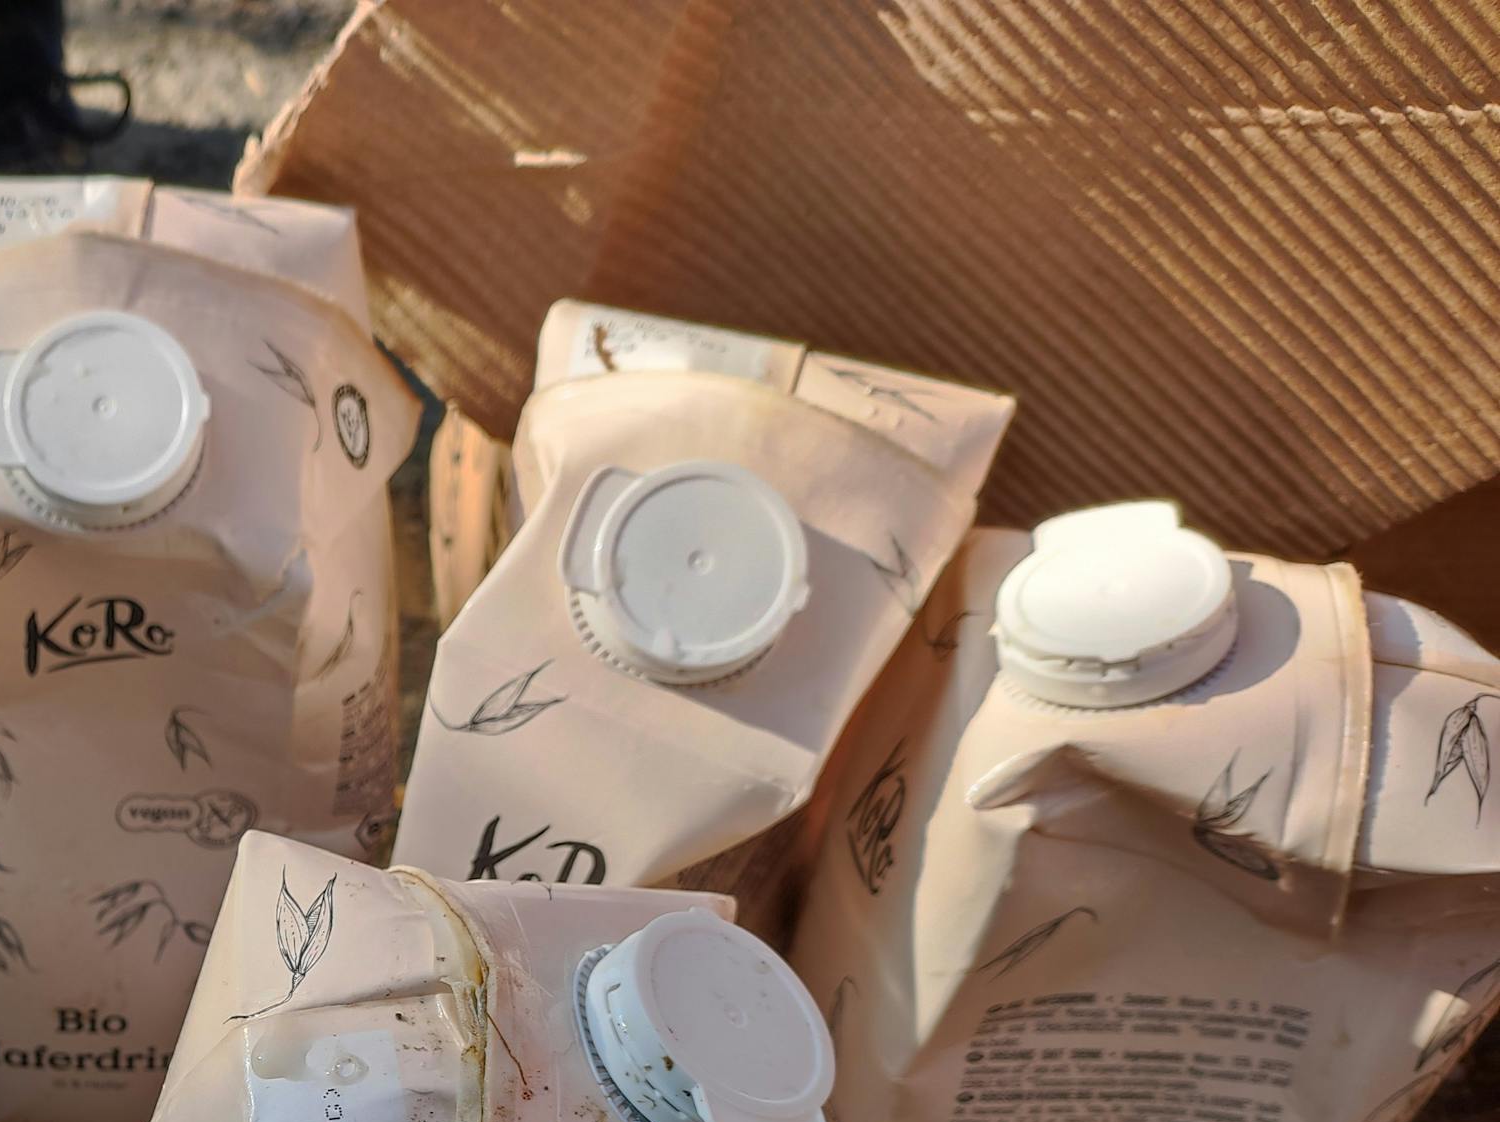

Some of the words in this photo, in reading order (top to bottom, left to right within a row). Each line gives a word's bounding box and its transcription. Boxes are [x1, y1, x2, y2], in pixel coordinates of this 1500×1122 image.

[25, 595, 176, 677] KoRo
[468, 815, 608, 886] KR
[55, 1007, 127, 1035] Bio
